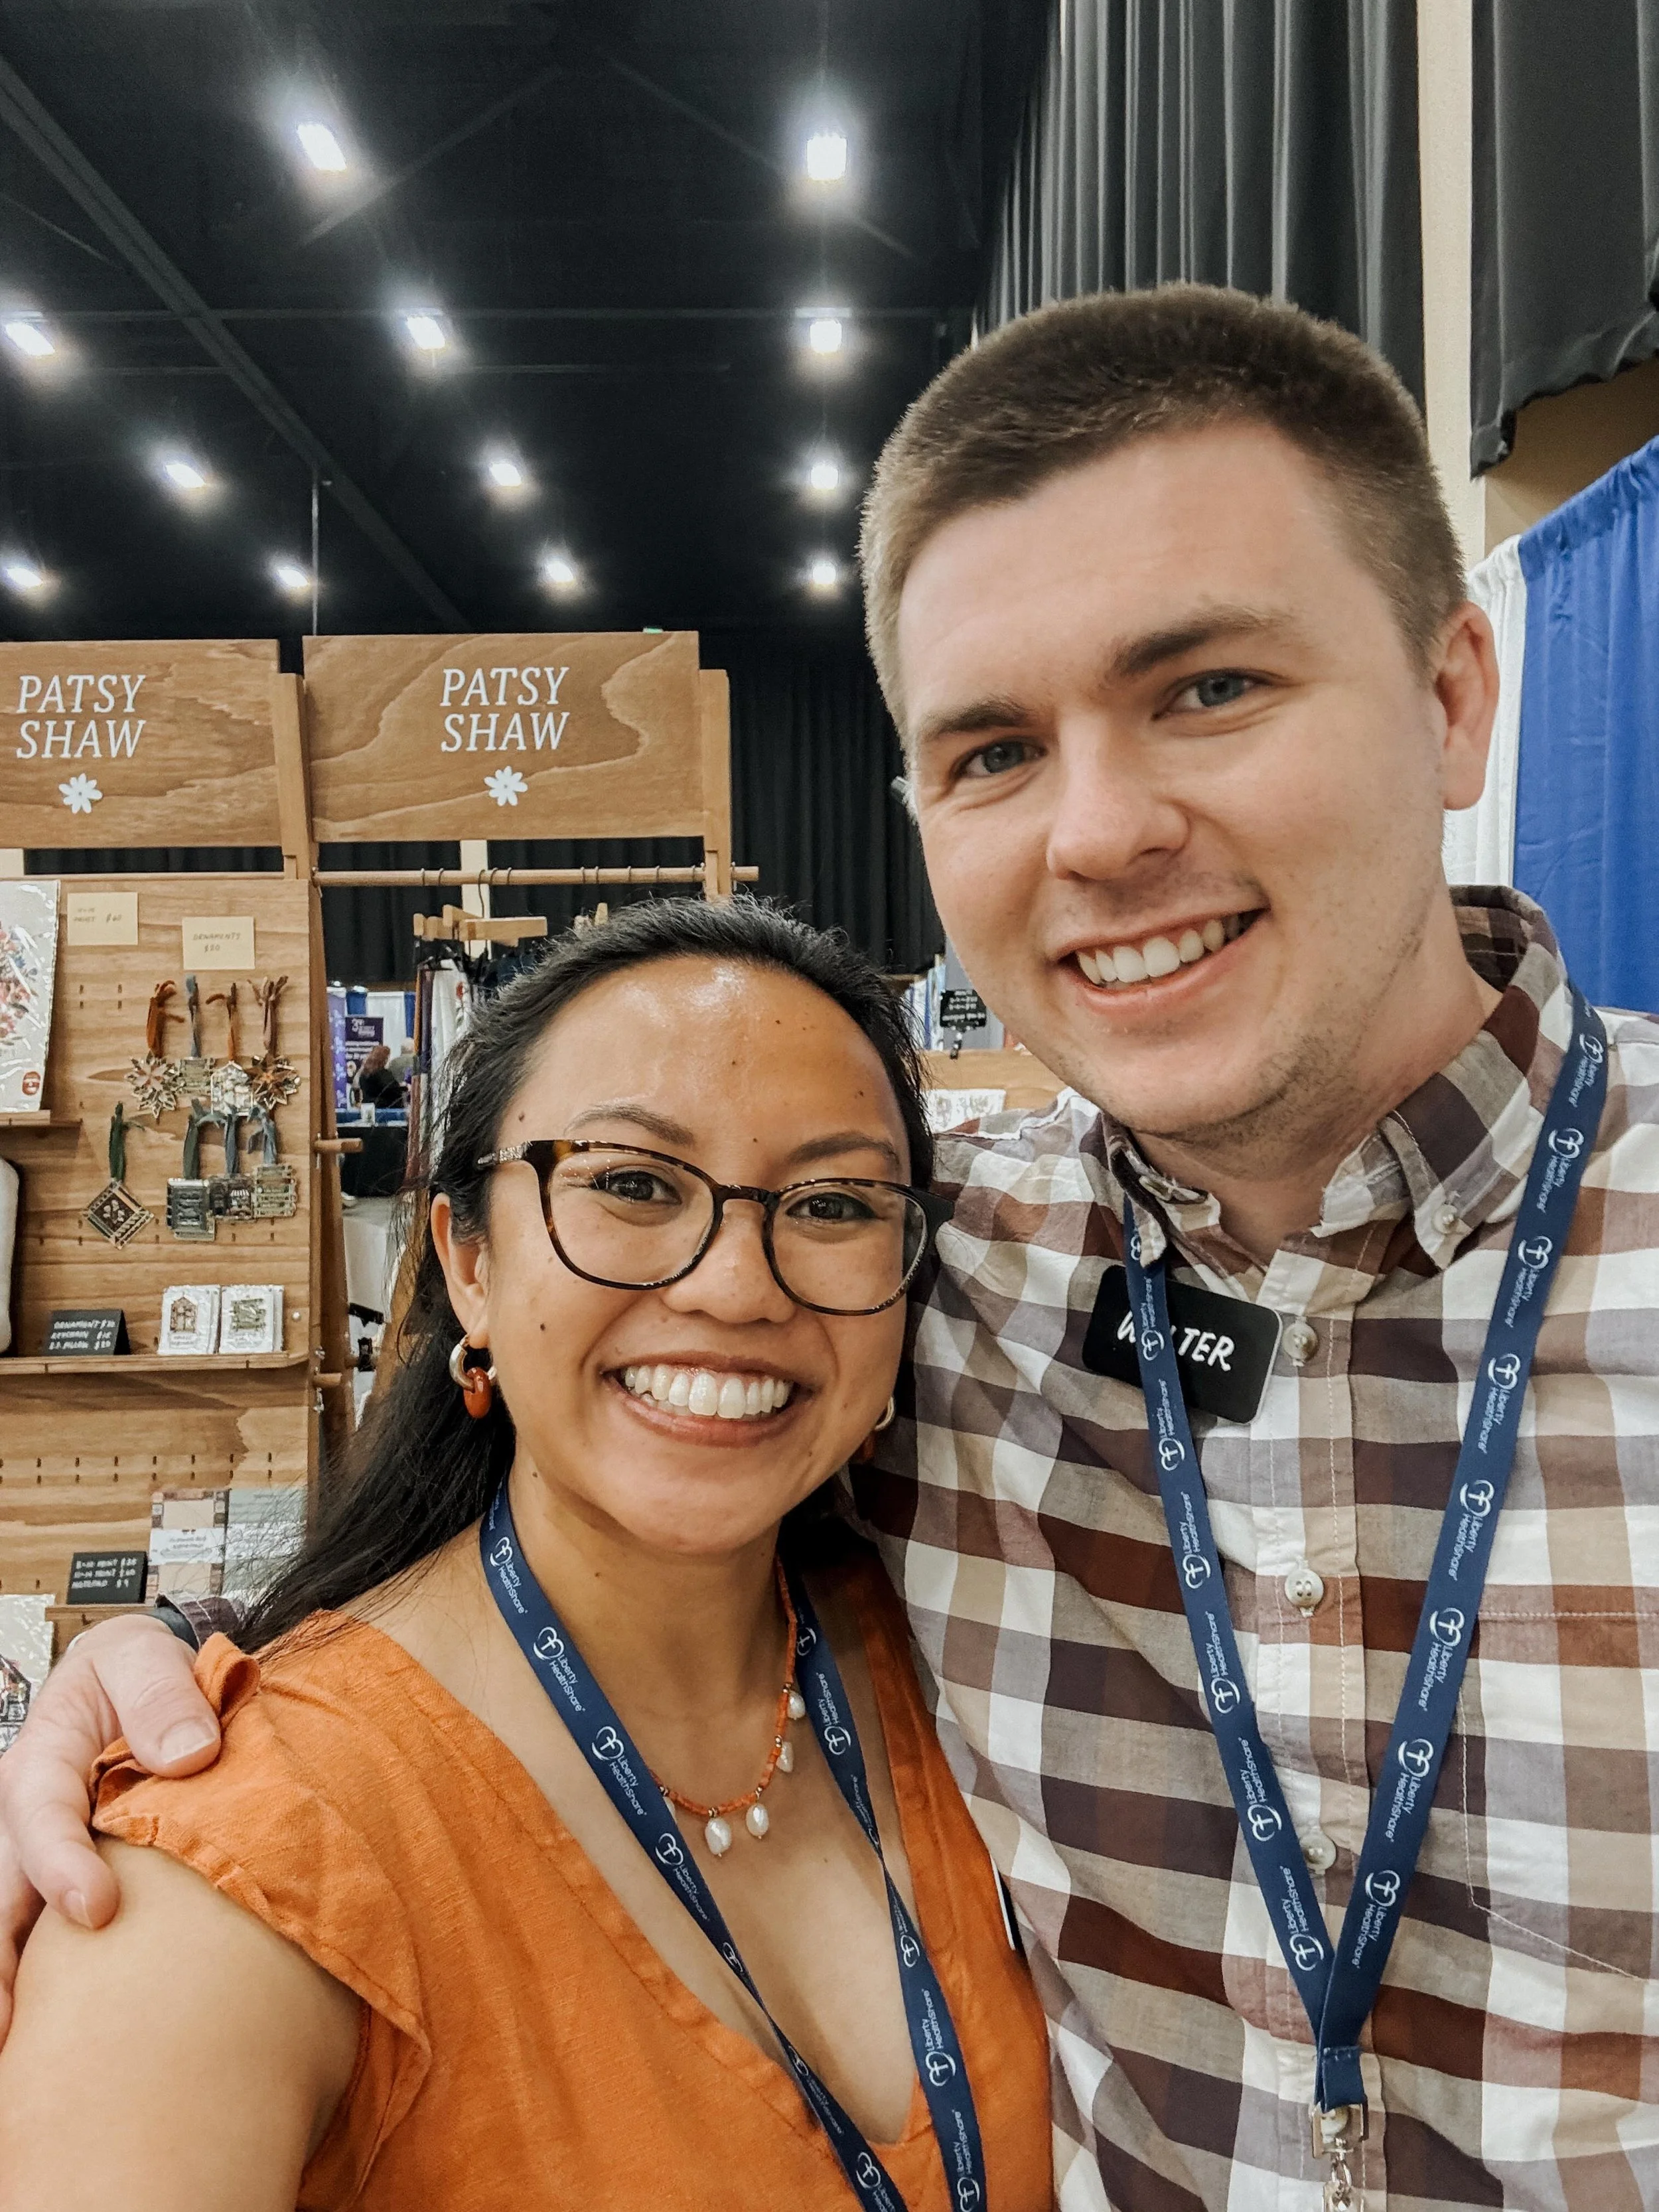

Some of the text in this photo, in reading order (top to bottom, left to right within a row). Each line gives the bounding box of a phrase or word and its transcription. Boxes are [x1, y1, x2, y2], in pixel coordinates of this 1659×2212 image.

[17, 674, 146, 713] PATSY
[439, 666, 569, 706] PATSY
[17, 719, 147, 759] SHAW
[441, 711, 570, 752] SHAW
[1117, 1311, 1235, 1372] WTER
[505, 1560, 522, 1587] Liberty
[557, 1655, 579, 1684] Liberty
[618, 1755, 639, 1787] Liberty
[1402, 1777, 1421, 1814] Liberty
[680, 1864, 699, 1894] Liberty
[1370, 1907, 1387, 1941] Liberty
